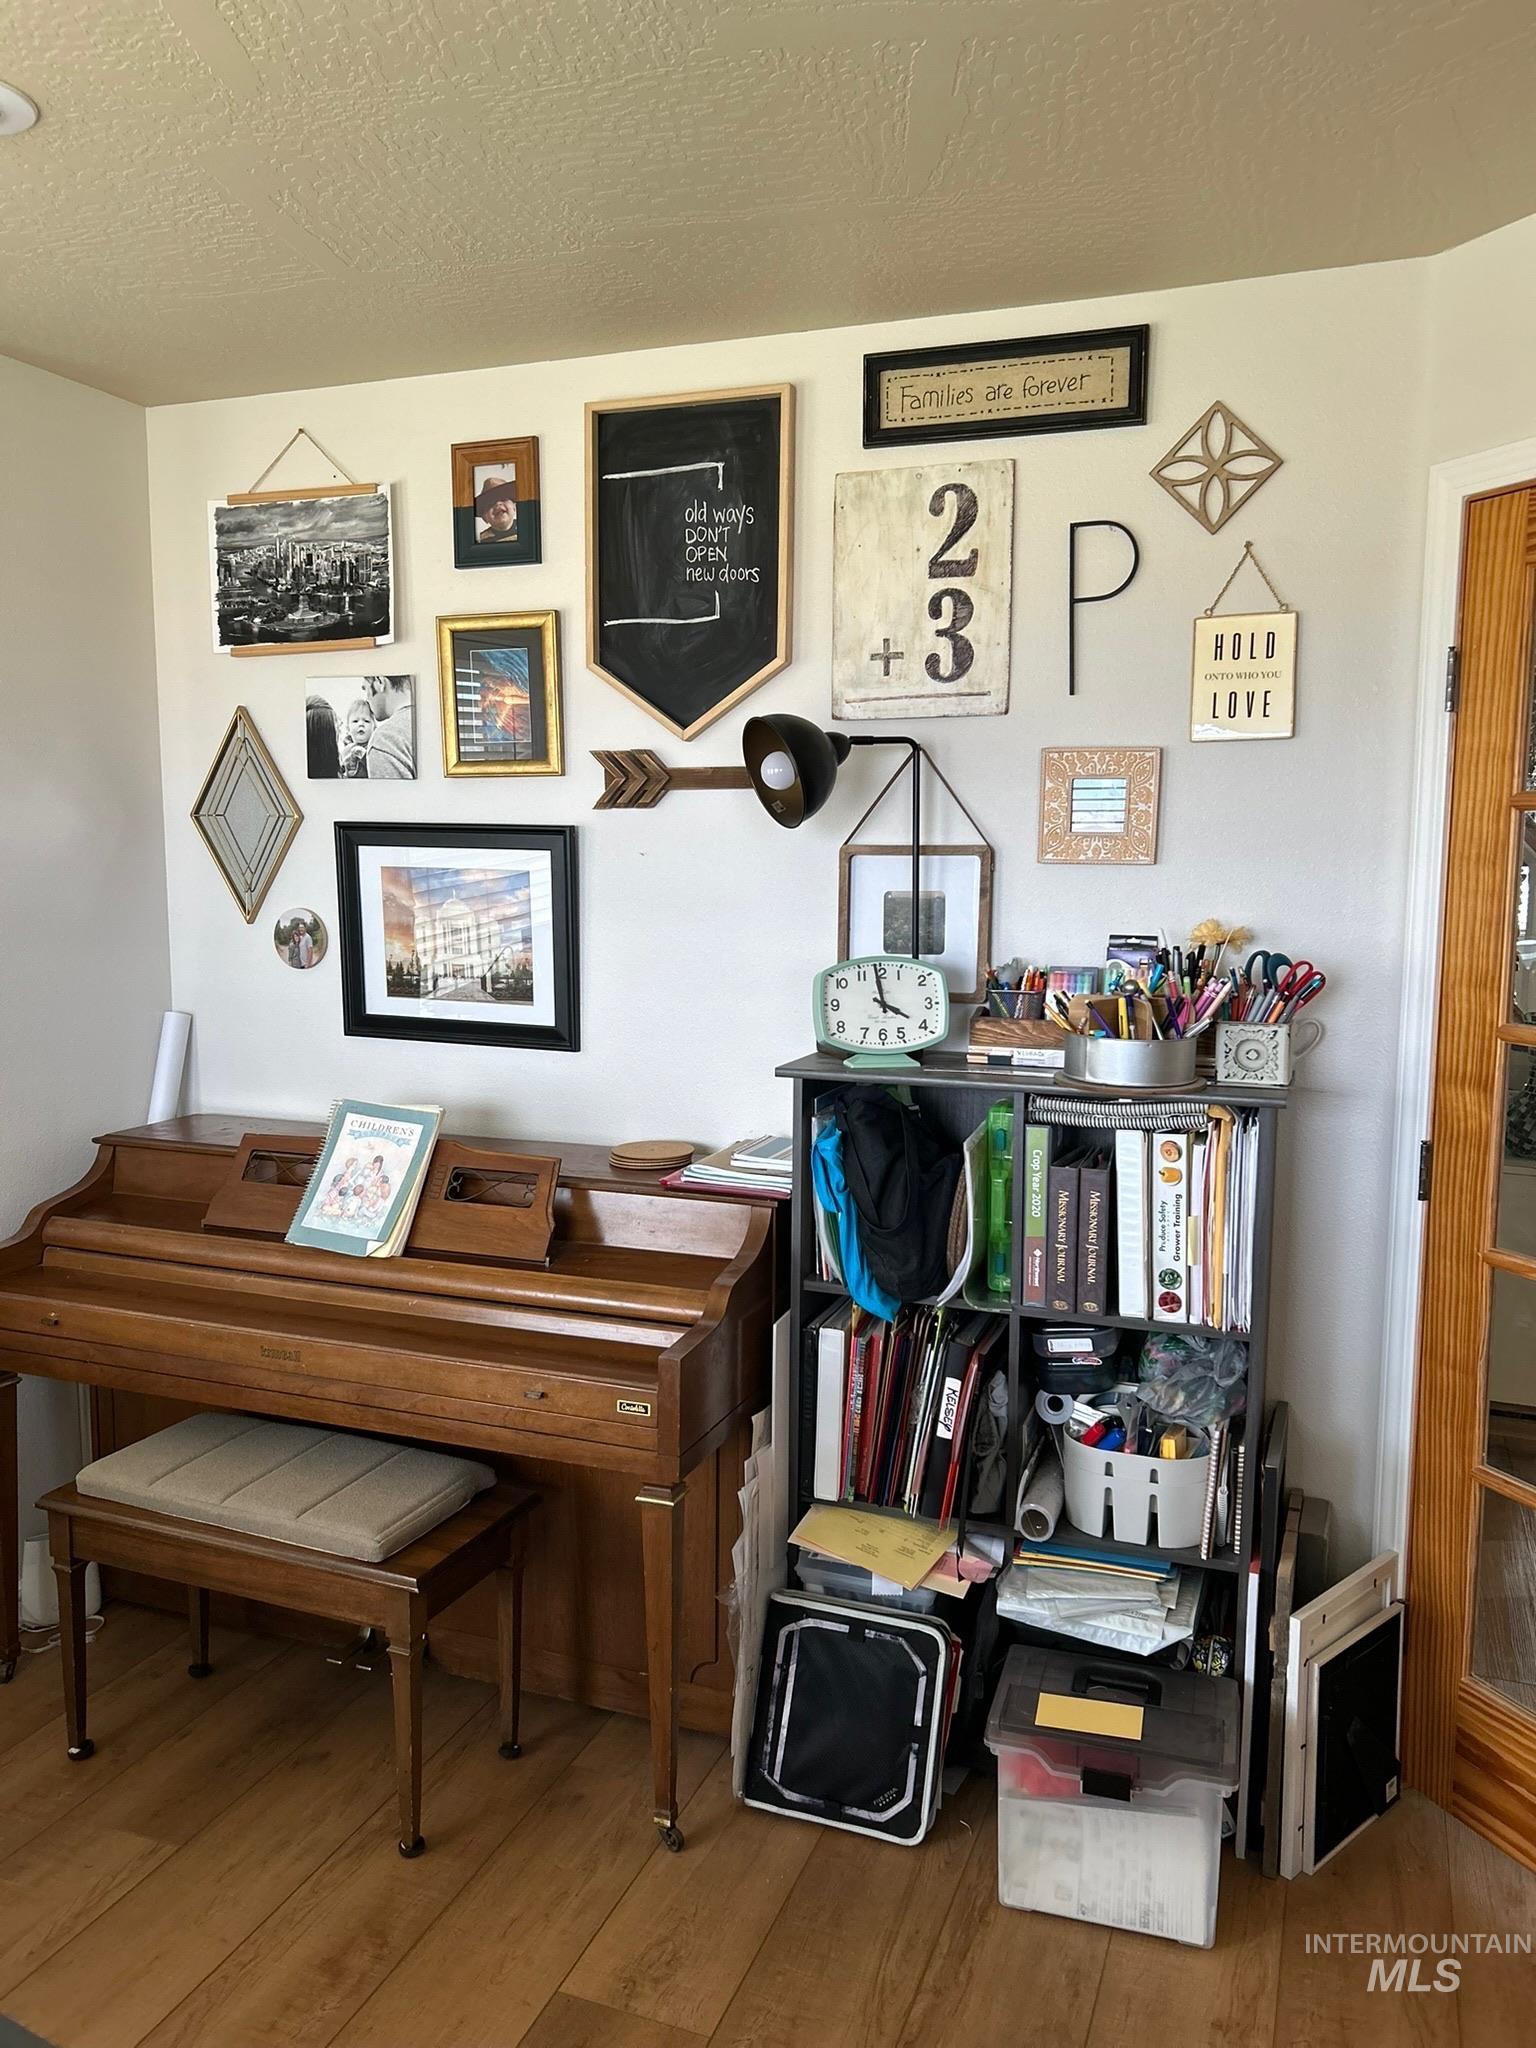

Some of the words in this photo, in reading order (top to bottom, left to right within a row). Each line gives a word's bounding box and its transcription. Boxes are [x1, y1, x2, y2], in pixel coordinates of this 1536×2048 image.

[901, 383, 974, 414] Families
[985, 384, 1014, 402] are
[1023, 374, 1092, 399] forever
[685, 499, 707, 523] old
[713, 504, 755, 534] ways
[685, 526, 730, 544] DON'T
[928, 482, 979, 580] 2
[685, 545, 728, 563] OPEN
[686, 566, 716, 582] new
[718, 564, 761, 583] doors
[924, 587, 976, 685] 3
[1213, 631, 1276, 661] HOLD
[1204, 672, 1234, 681] ONTO
[1235, 671, 1259, 680] WHO
[1261, 670, 1282, 679] YOU
[1212, 690, 1272, 719] LOVE
[876, 967, 887, 980] 2
[918, 975, 927, 987] 2
[830, 999, 840, 1012] 9
[924, 997, 933, 1010] 3
[836, 1020, 846, 1034] 8
[860, 1027, 870, 1040] 7
[878, 1028, 888, 1041] 6
[896, 1027, 906, 1040] 5
[918, 1019, 928, 1032] 4
[1030, 1149, 1043, 1170] Crop
[1031, 1171, 1043, 1191] Year
[1031, 1193, 1042, 1218] 2020
[1158, 1200, 1168, 1223] Safety
[1172, 1193, 1183, 1228] Training
[1173, 1229, 1181, 1262] Grower
[938, 1386, 959, 1433] KELSEY
